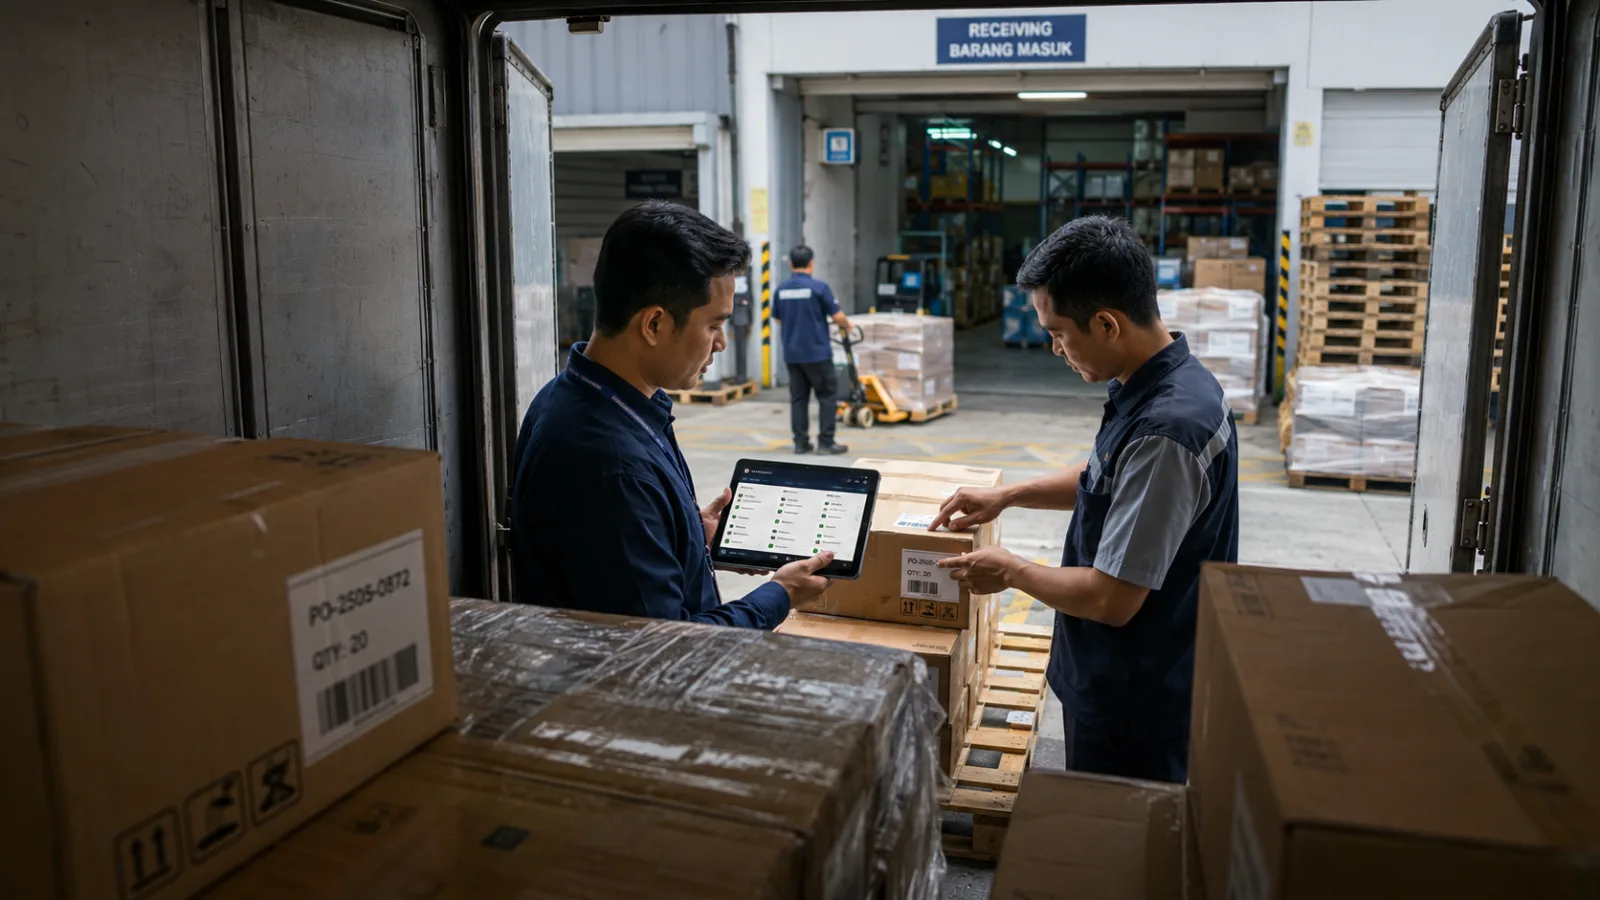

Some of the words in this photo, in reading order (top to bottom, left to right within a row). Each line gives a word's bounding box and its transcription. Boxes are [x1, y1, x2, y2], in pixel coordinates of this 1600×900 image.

[968, 21, 1053, 38] RECEIVING
[949, 42, 1013, 58] BARANG
[1017, 41, 1073, 57] MASUK
[309, 568, 410, 628] PO-2505-0872
[312, 642, 347, 671] QTY:
[350, 630, 369, 654] 20
